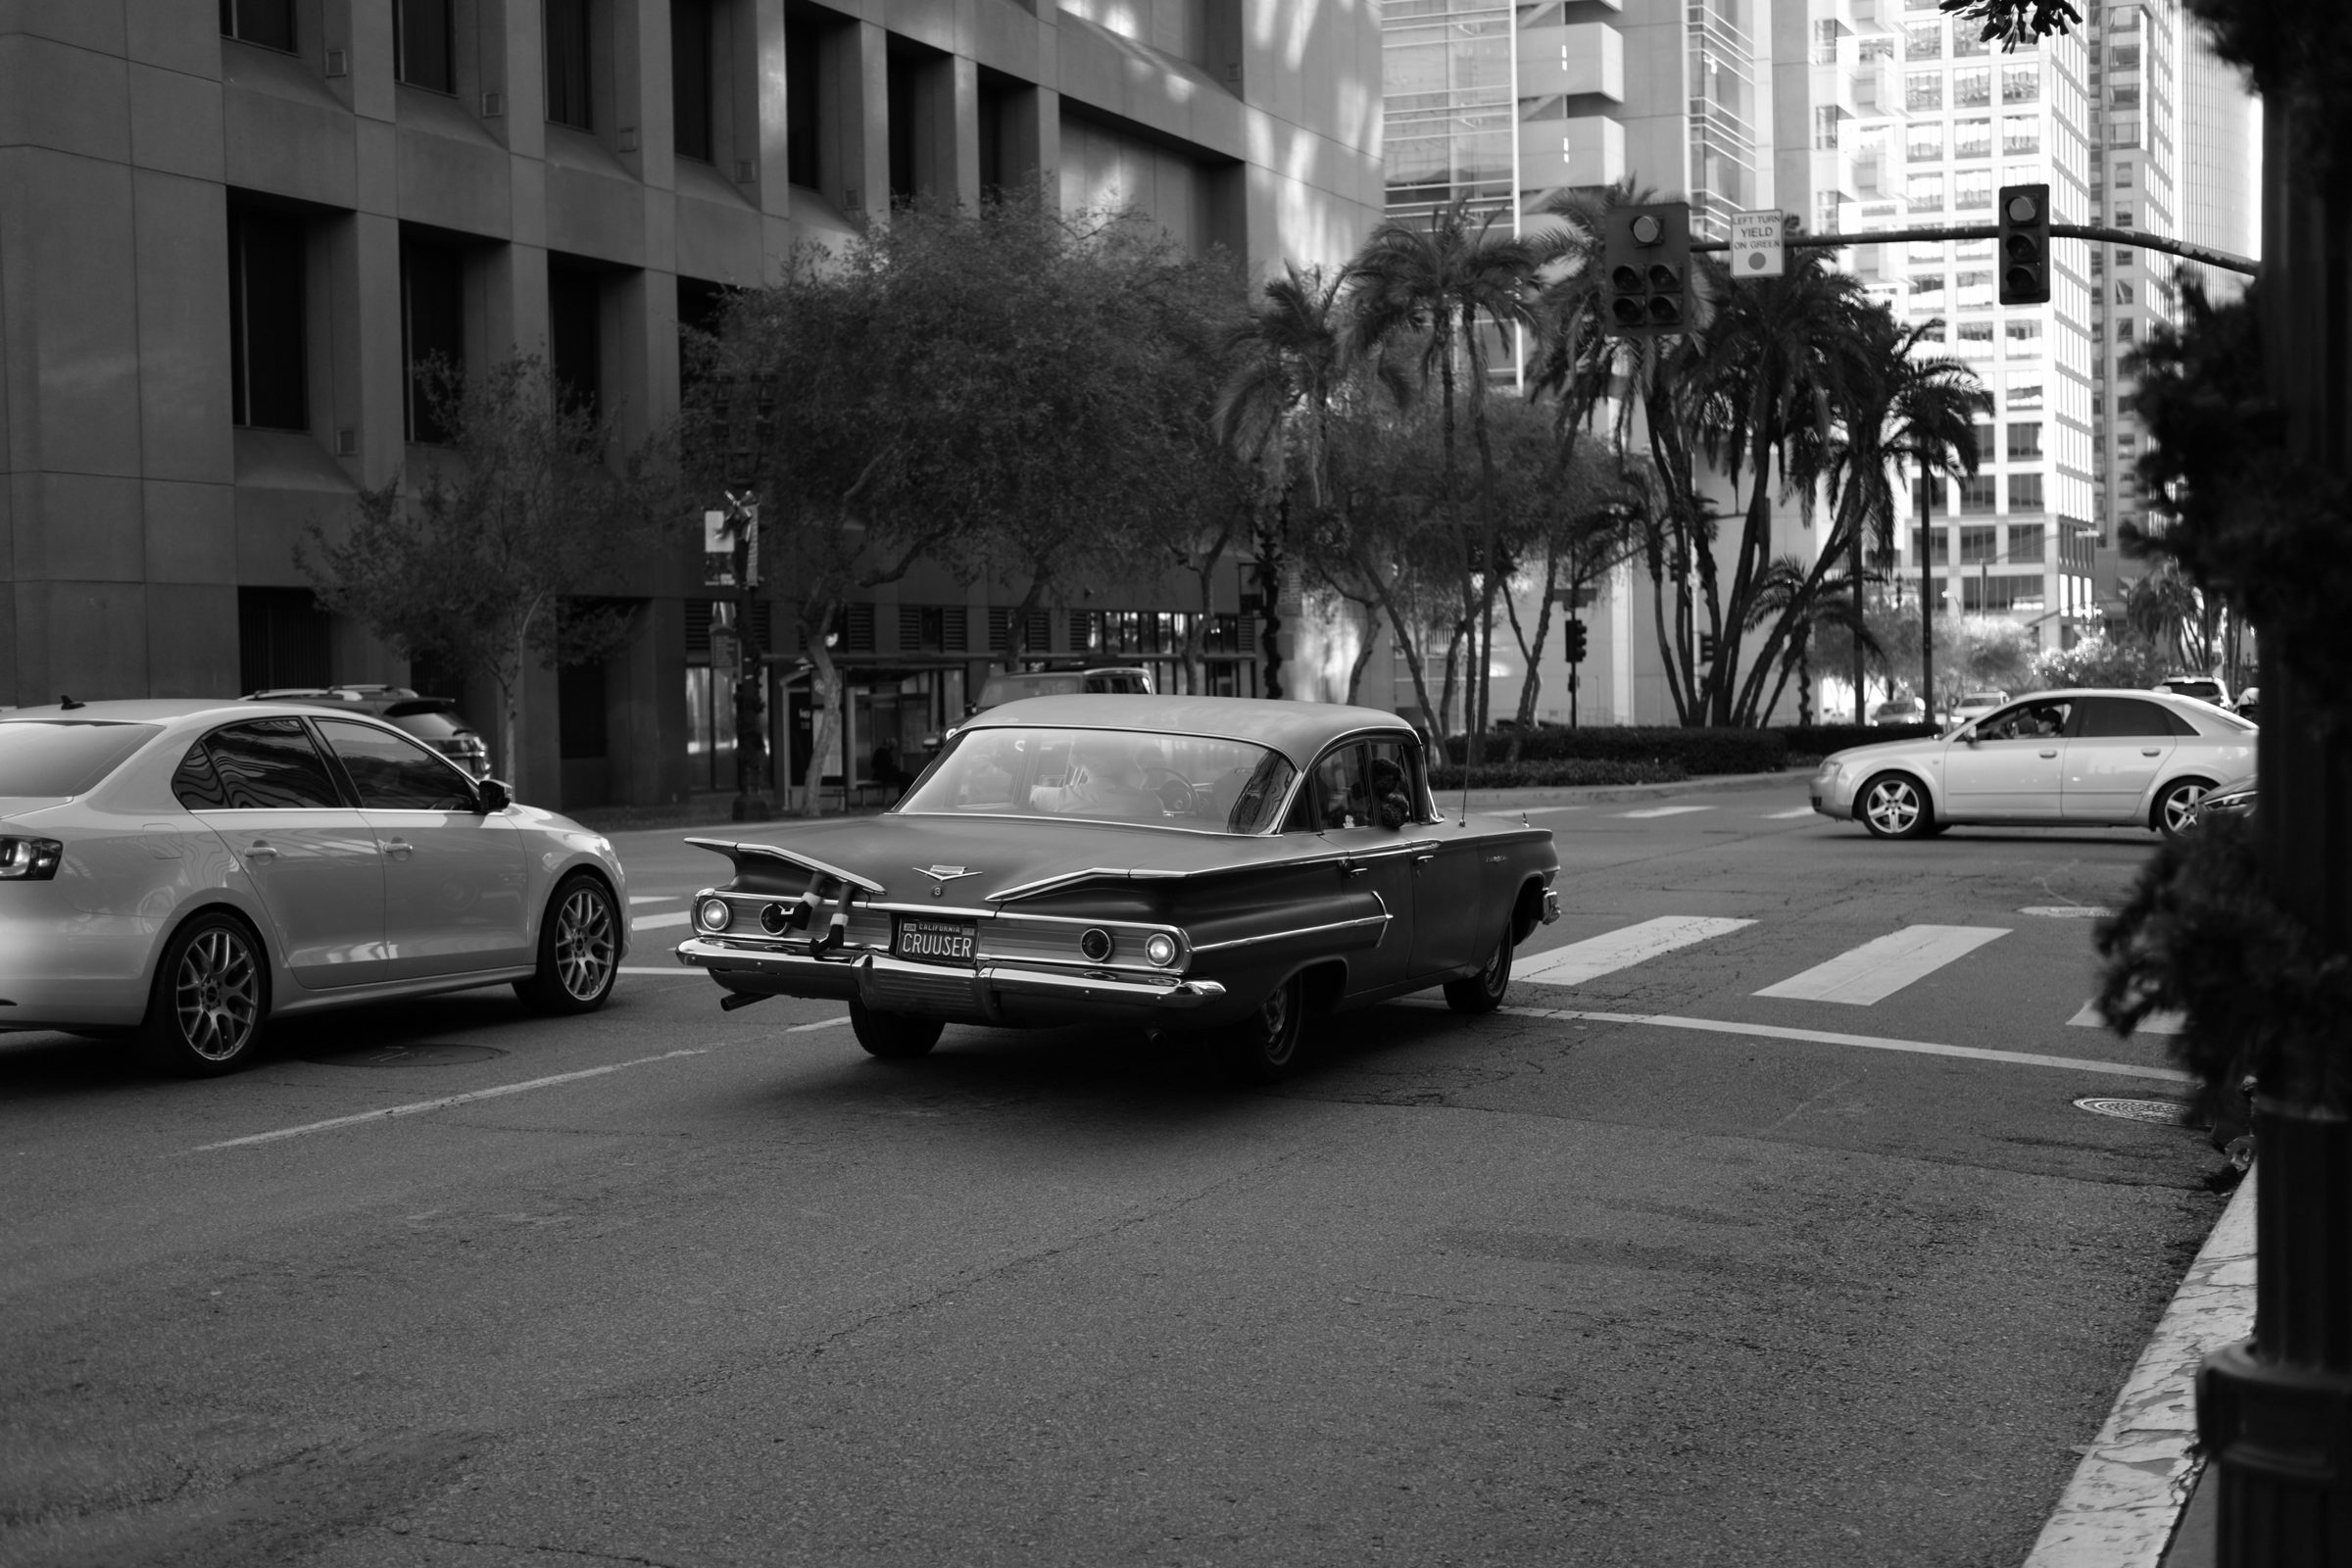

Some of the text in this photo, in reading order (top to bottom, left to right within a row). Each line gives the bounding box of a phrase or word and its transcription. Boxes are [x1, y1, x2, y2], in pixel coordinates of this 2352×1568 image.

[1740, 226, 1773, 237] YIELD
[1734, 239, 1780, 250] ON GREEN
[919, 923, 960, 932] CALIFORNIA
[903, 933, 972, 957] CRUUSER
